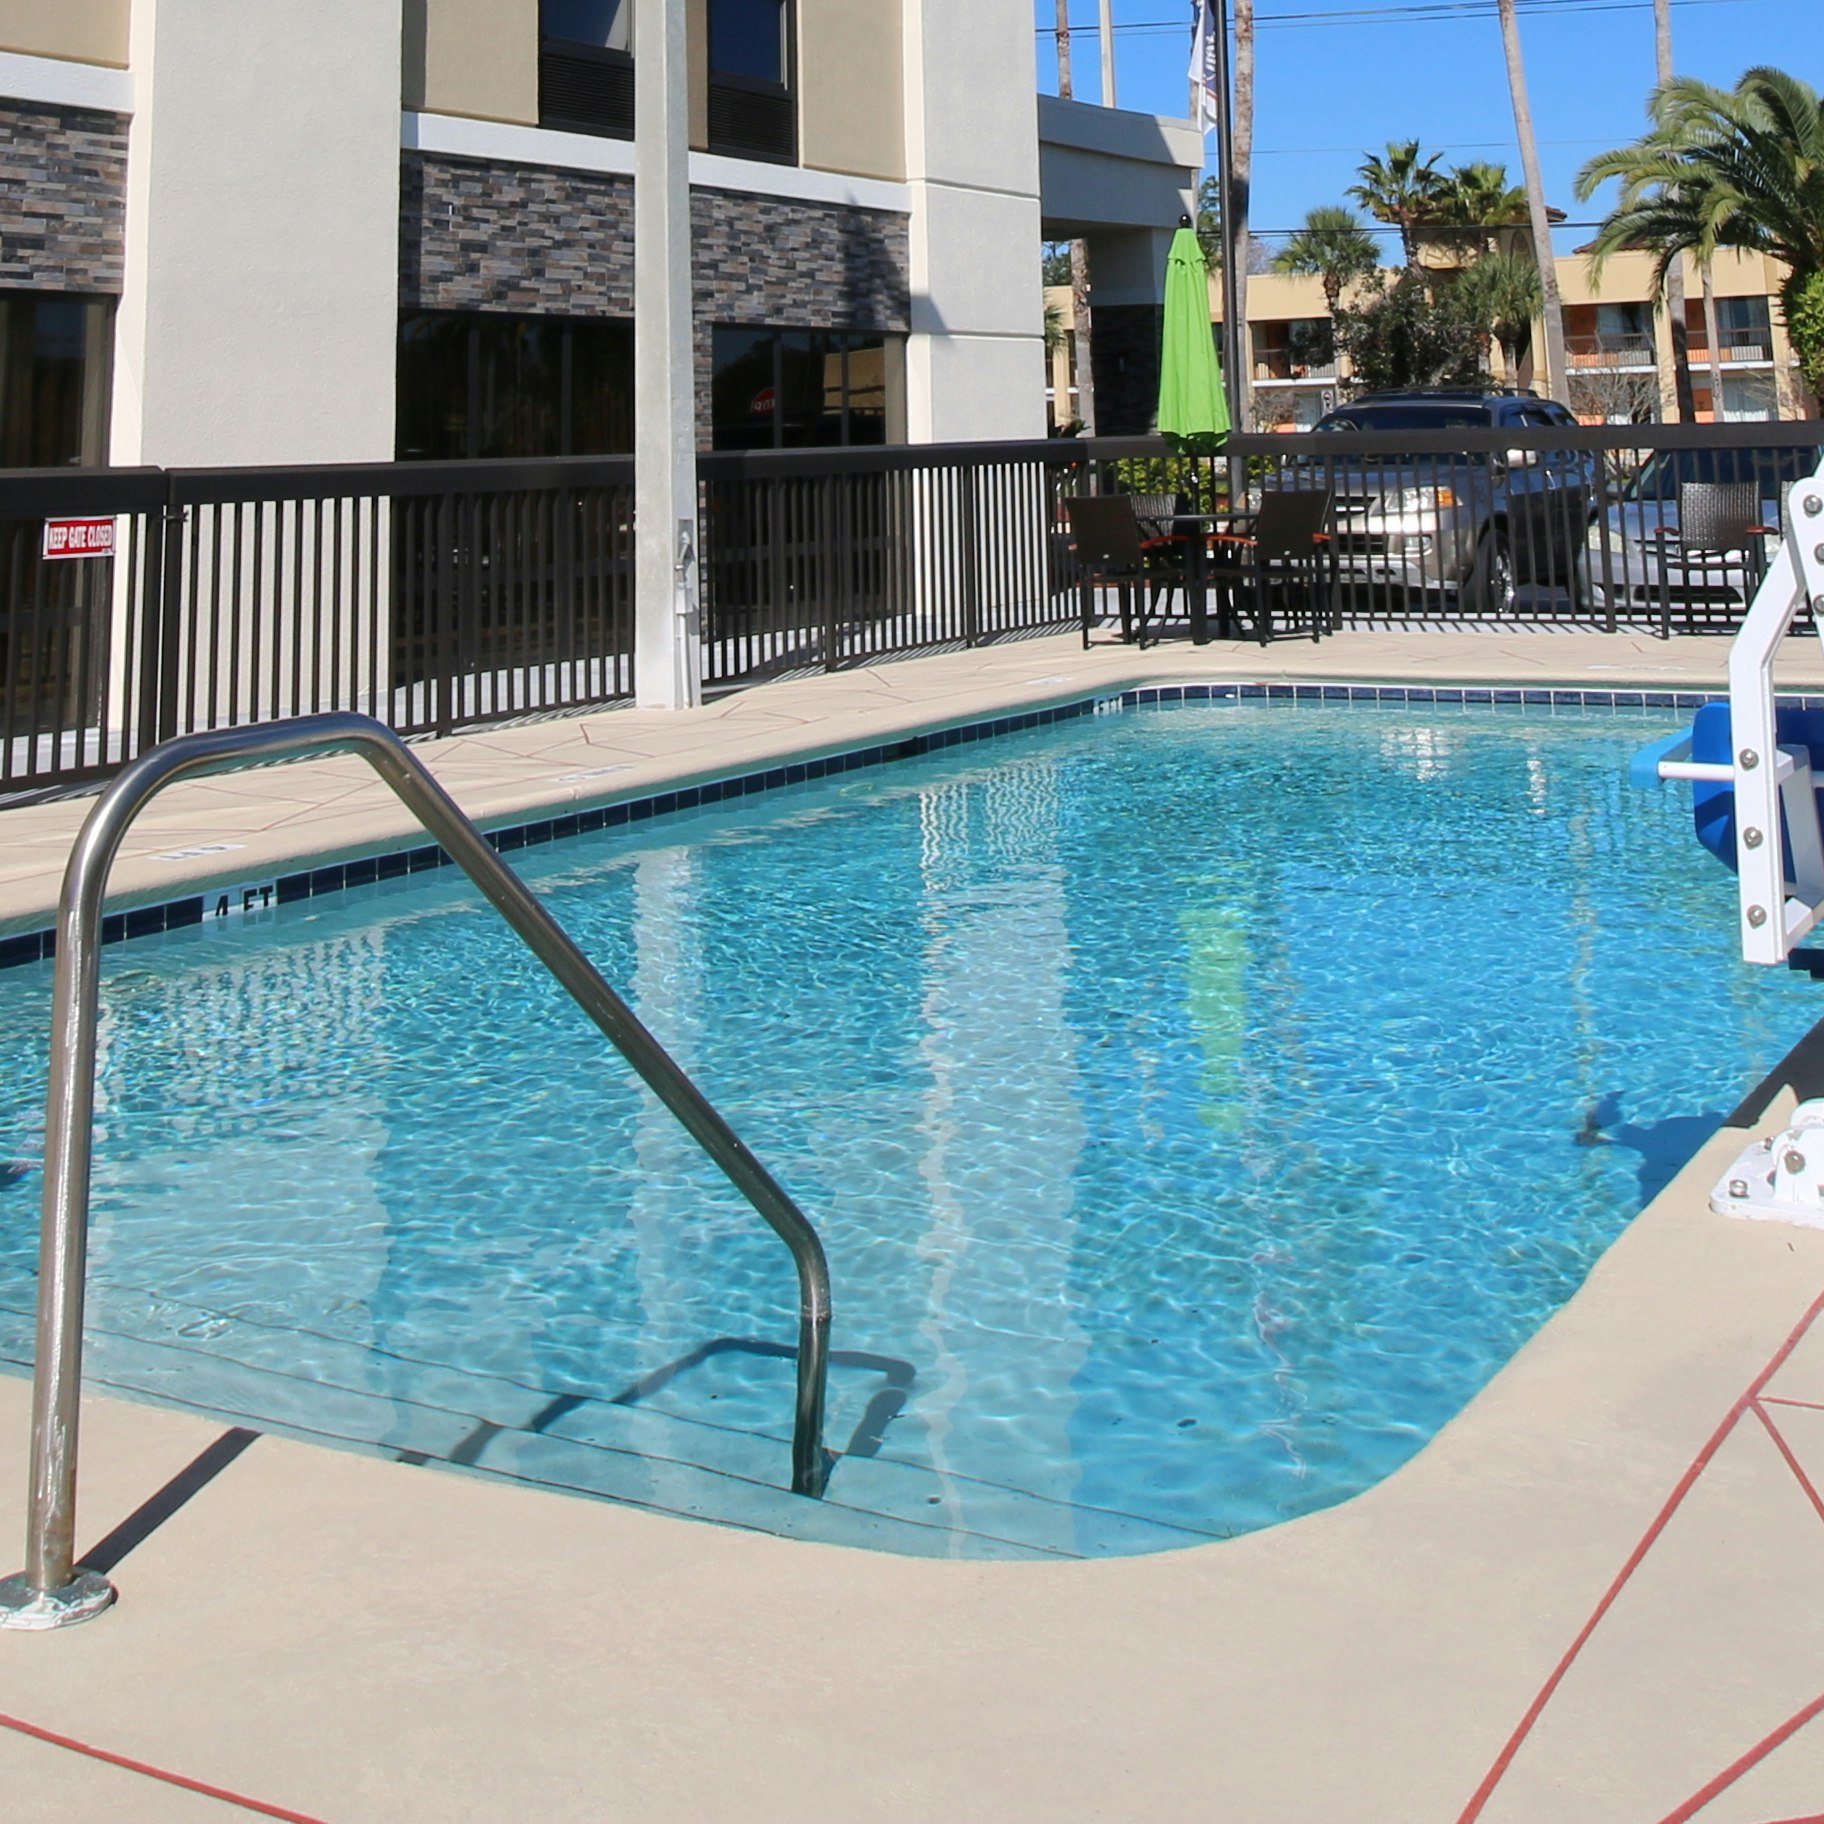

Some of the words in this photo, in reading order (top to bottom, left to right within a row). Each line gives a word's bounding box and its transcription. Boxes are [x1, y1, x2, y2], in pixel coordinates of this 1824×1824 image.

[48, 526, 68, 550] KEEP
[68, 525, 87, 549] GATE
[87, 524, 113, 548] CLOSED
[243, 885, 274, 911] FT
